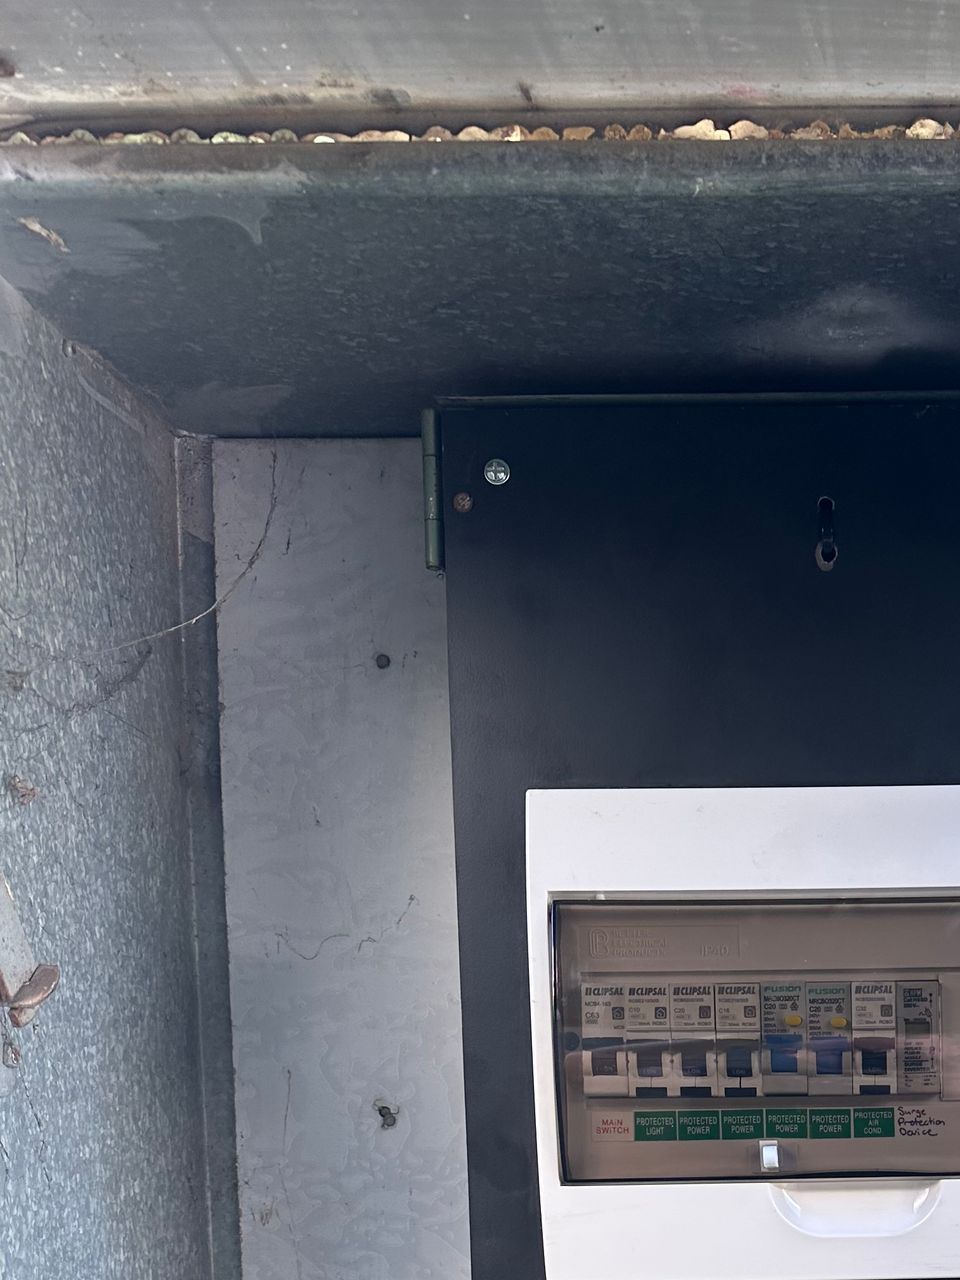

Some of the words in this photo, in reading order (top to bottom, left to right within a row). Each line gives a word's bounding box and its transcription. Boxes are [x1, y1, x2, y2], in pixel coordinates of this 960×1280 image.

[592, 986, 625, 996] CLIPSAL
[636, 987, 667, 996] CLIPSAL
[679, 986, 711, 996] CLIPSAL
[724, 986, 756, 995] CLIPSAL
[862, 985, 893, 994] CLIPSAL
[763, 1002, 776, 1010] C20
[808, 1005, 822, 1013] C20
[584, 1011, 600, 1019] C63
[854, 1111, 893, 1119] PROTECTED
[897, 1106, 926, 1118] Surge
[635, 1116, 674, 1126] PROTECTED
[679, 1116, 718, 1125] PROTECTED
[722, 1115, 761, 1124] PROTECTED
[767, 1114, 806, 1124] PROTECTED
[811, 1115, 849, 1124] PROTECTED
[897, 1116, 945, 1127] Protection
[645, 1126, 665, 1135] LIGHT
[687, 1126, 711, 1135] POWER
[730, 1125, 754, 1134] POWER
[775, 1124, 799, 1133] POWER
[818, 1124, 843, 1133] POWER
